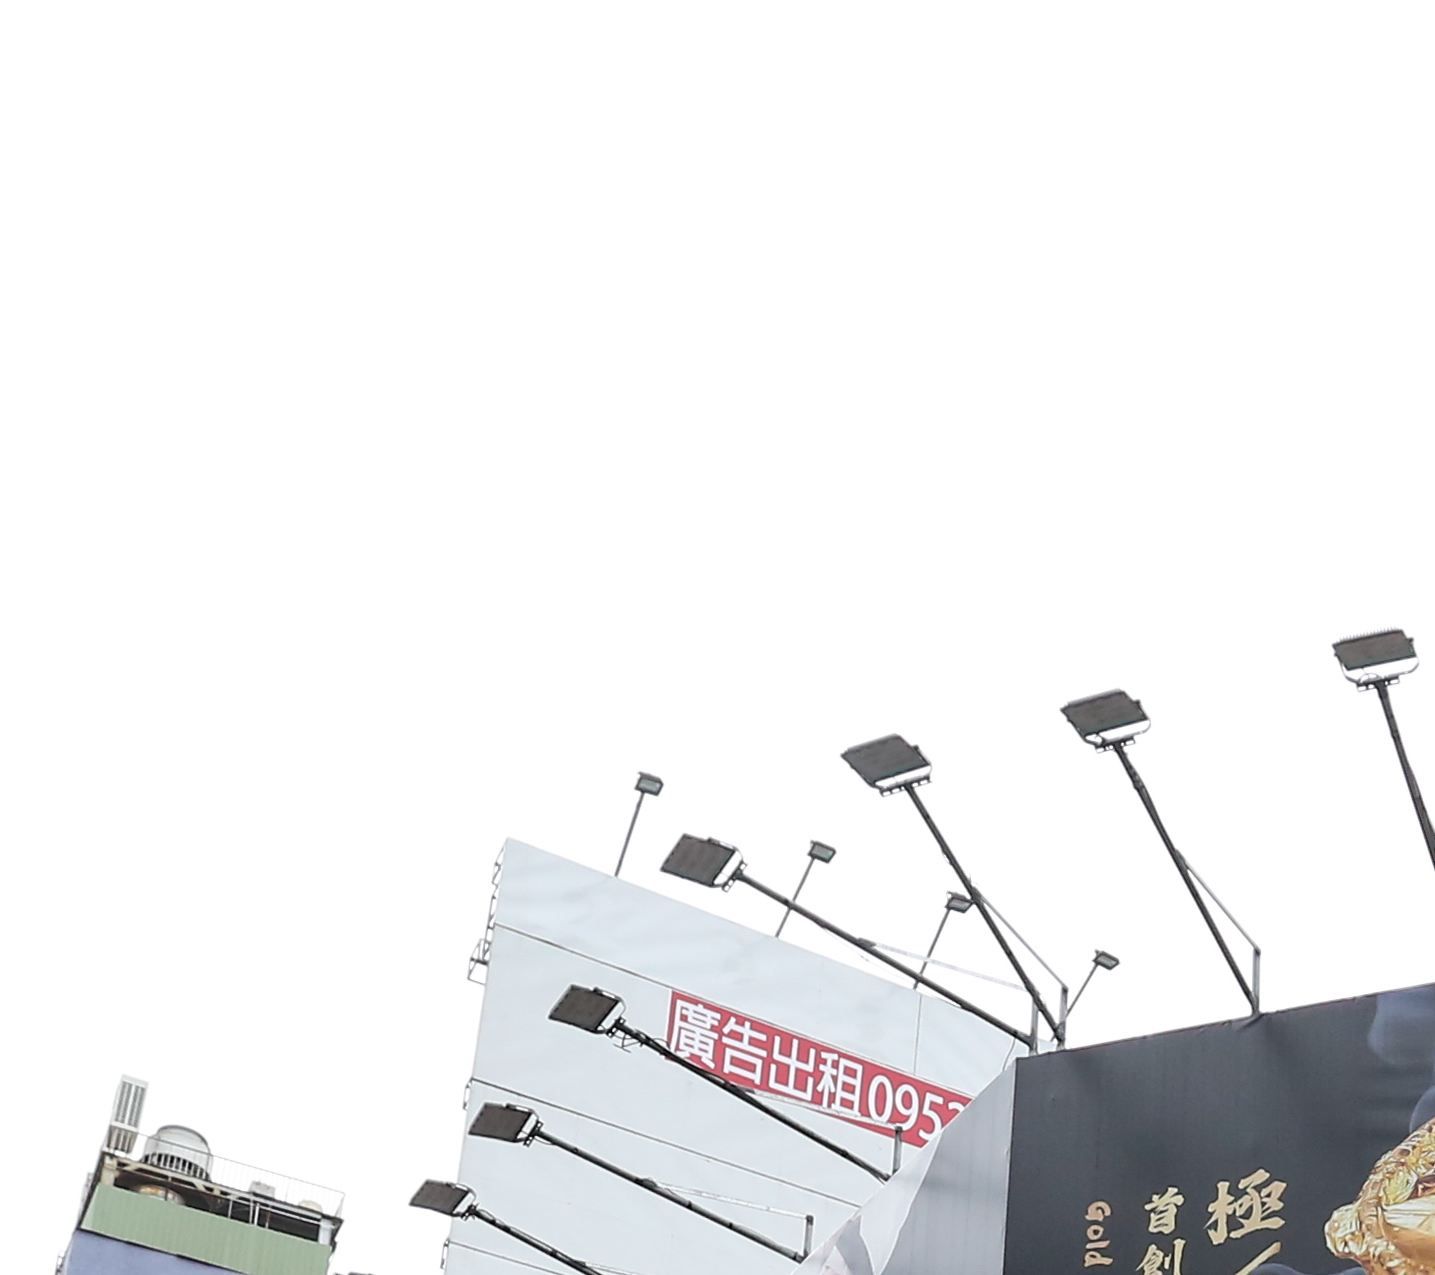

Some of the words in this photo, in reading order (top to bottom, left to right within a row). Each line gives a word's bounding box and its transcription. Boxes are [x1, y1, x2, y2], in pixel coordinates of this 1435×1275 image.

[671, 999, 862, 1119] 廣告出租
[1085, 1201, 1113, 1268] Gold
